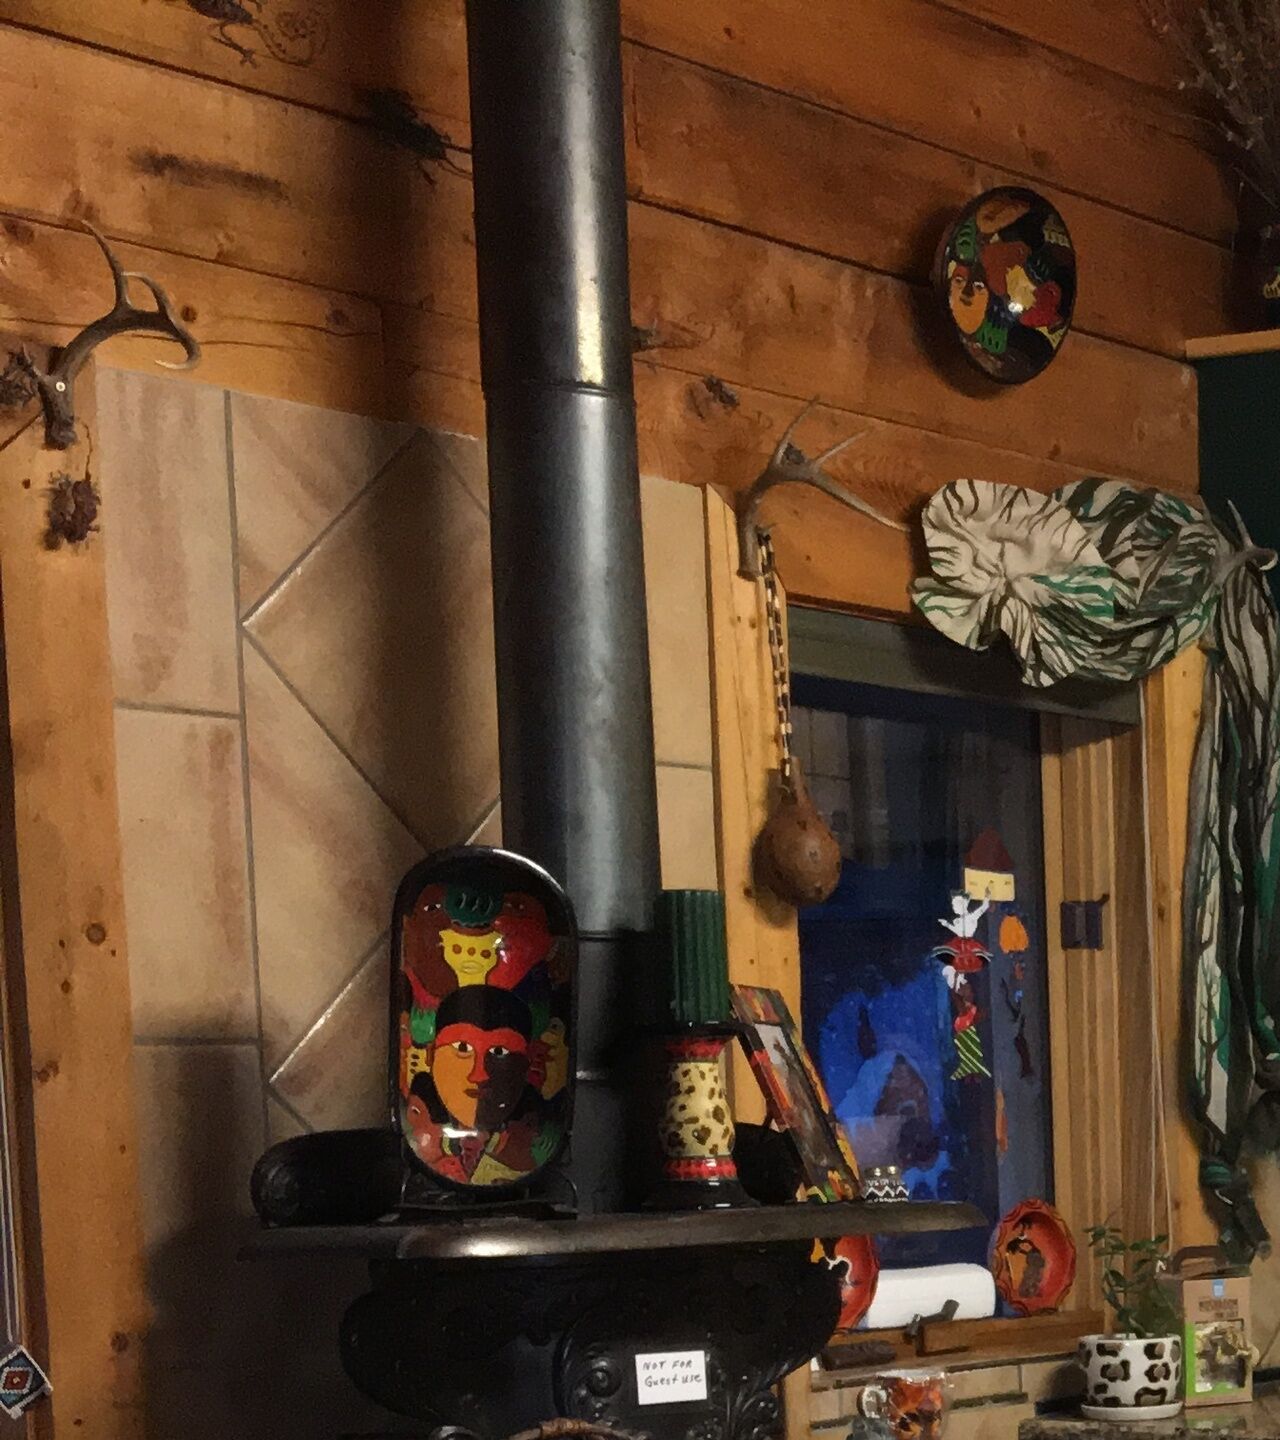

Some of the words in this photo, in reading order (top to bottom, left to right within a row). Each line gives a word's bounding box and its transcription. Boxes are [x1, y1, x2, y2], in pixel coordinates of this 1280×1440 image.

[642, 1360, 666, 1371] NOT
[672, 1359, 693, 1369] FOR
[644, 1376, 679, 1388] Guest
